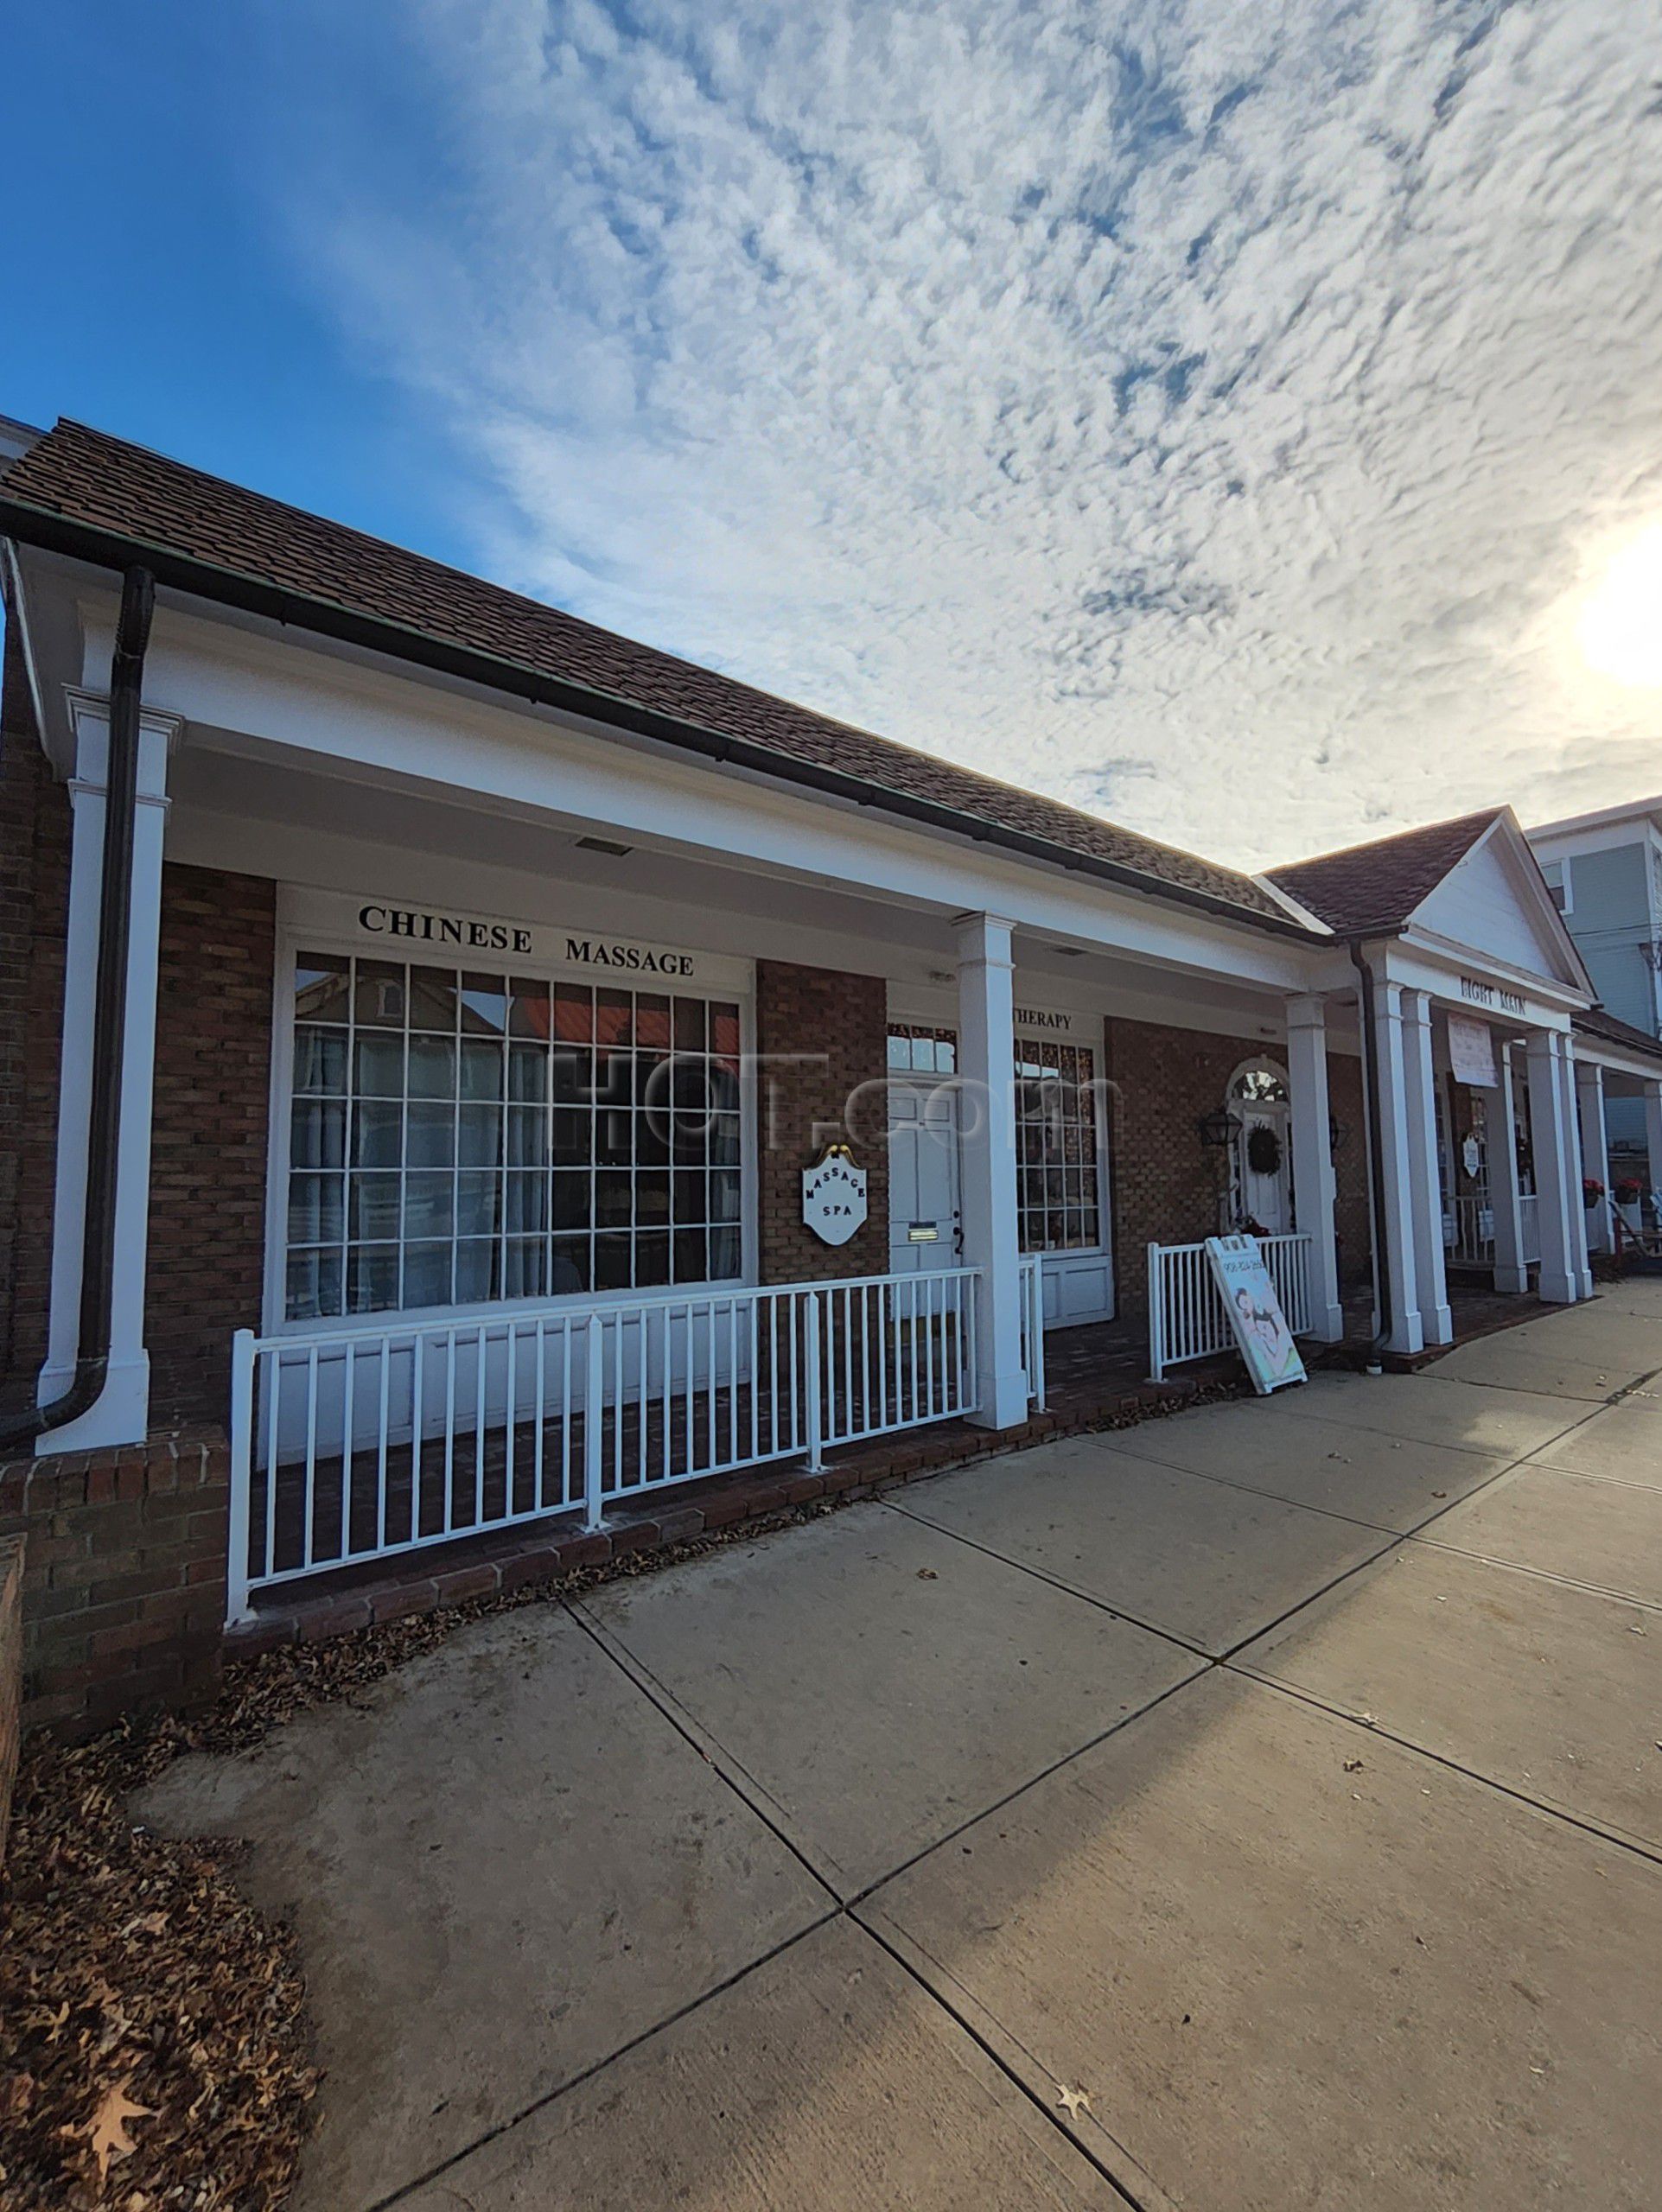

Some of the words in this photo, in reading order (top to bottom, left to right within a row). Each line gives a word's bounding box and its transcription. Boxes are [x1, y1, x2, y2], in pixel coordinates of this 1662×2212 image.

[359, 905, 532, 953] CHINESE
[566, 938, 694, 976] MASSAGE
[823, 1205, 851, 1216] SPA
